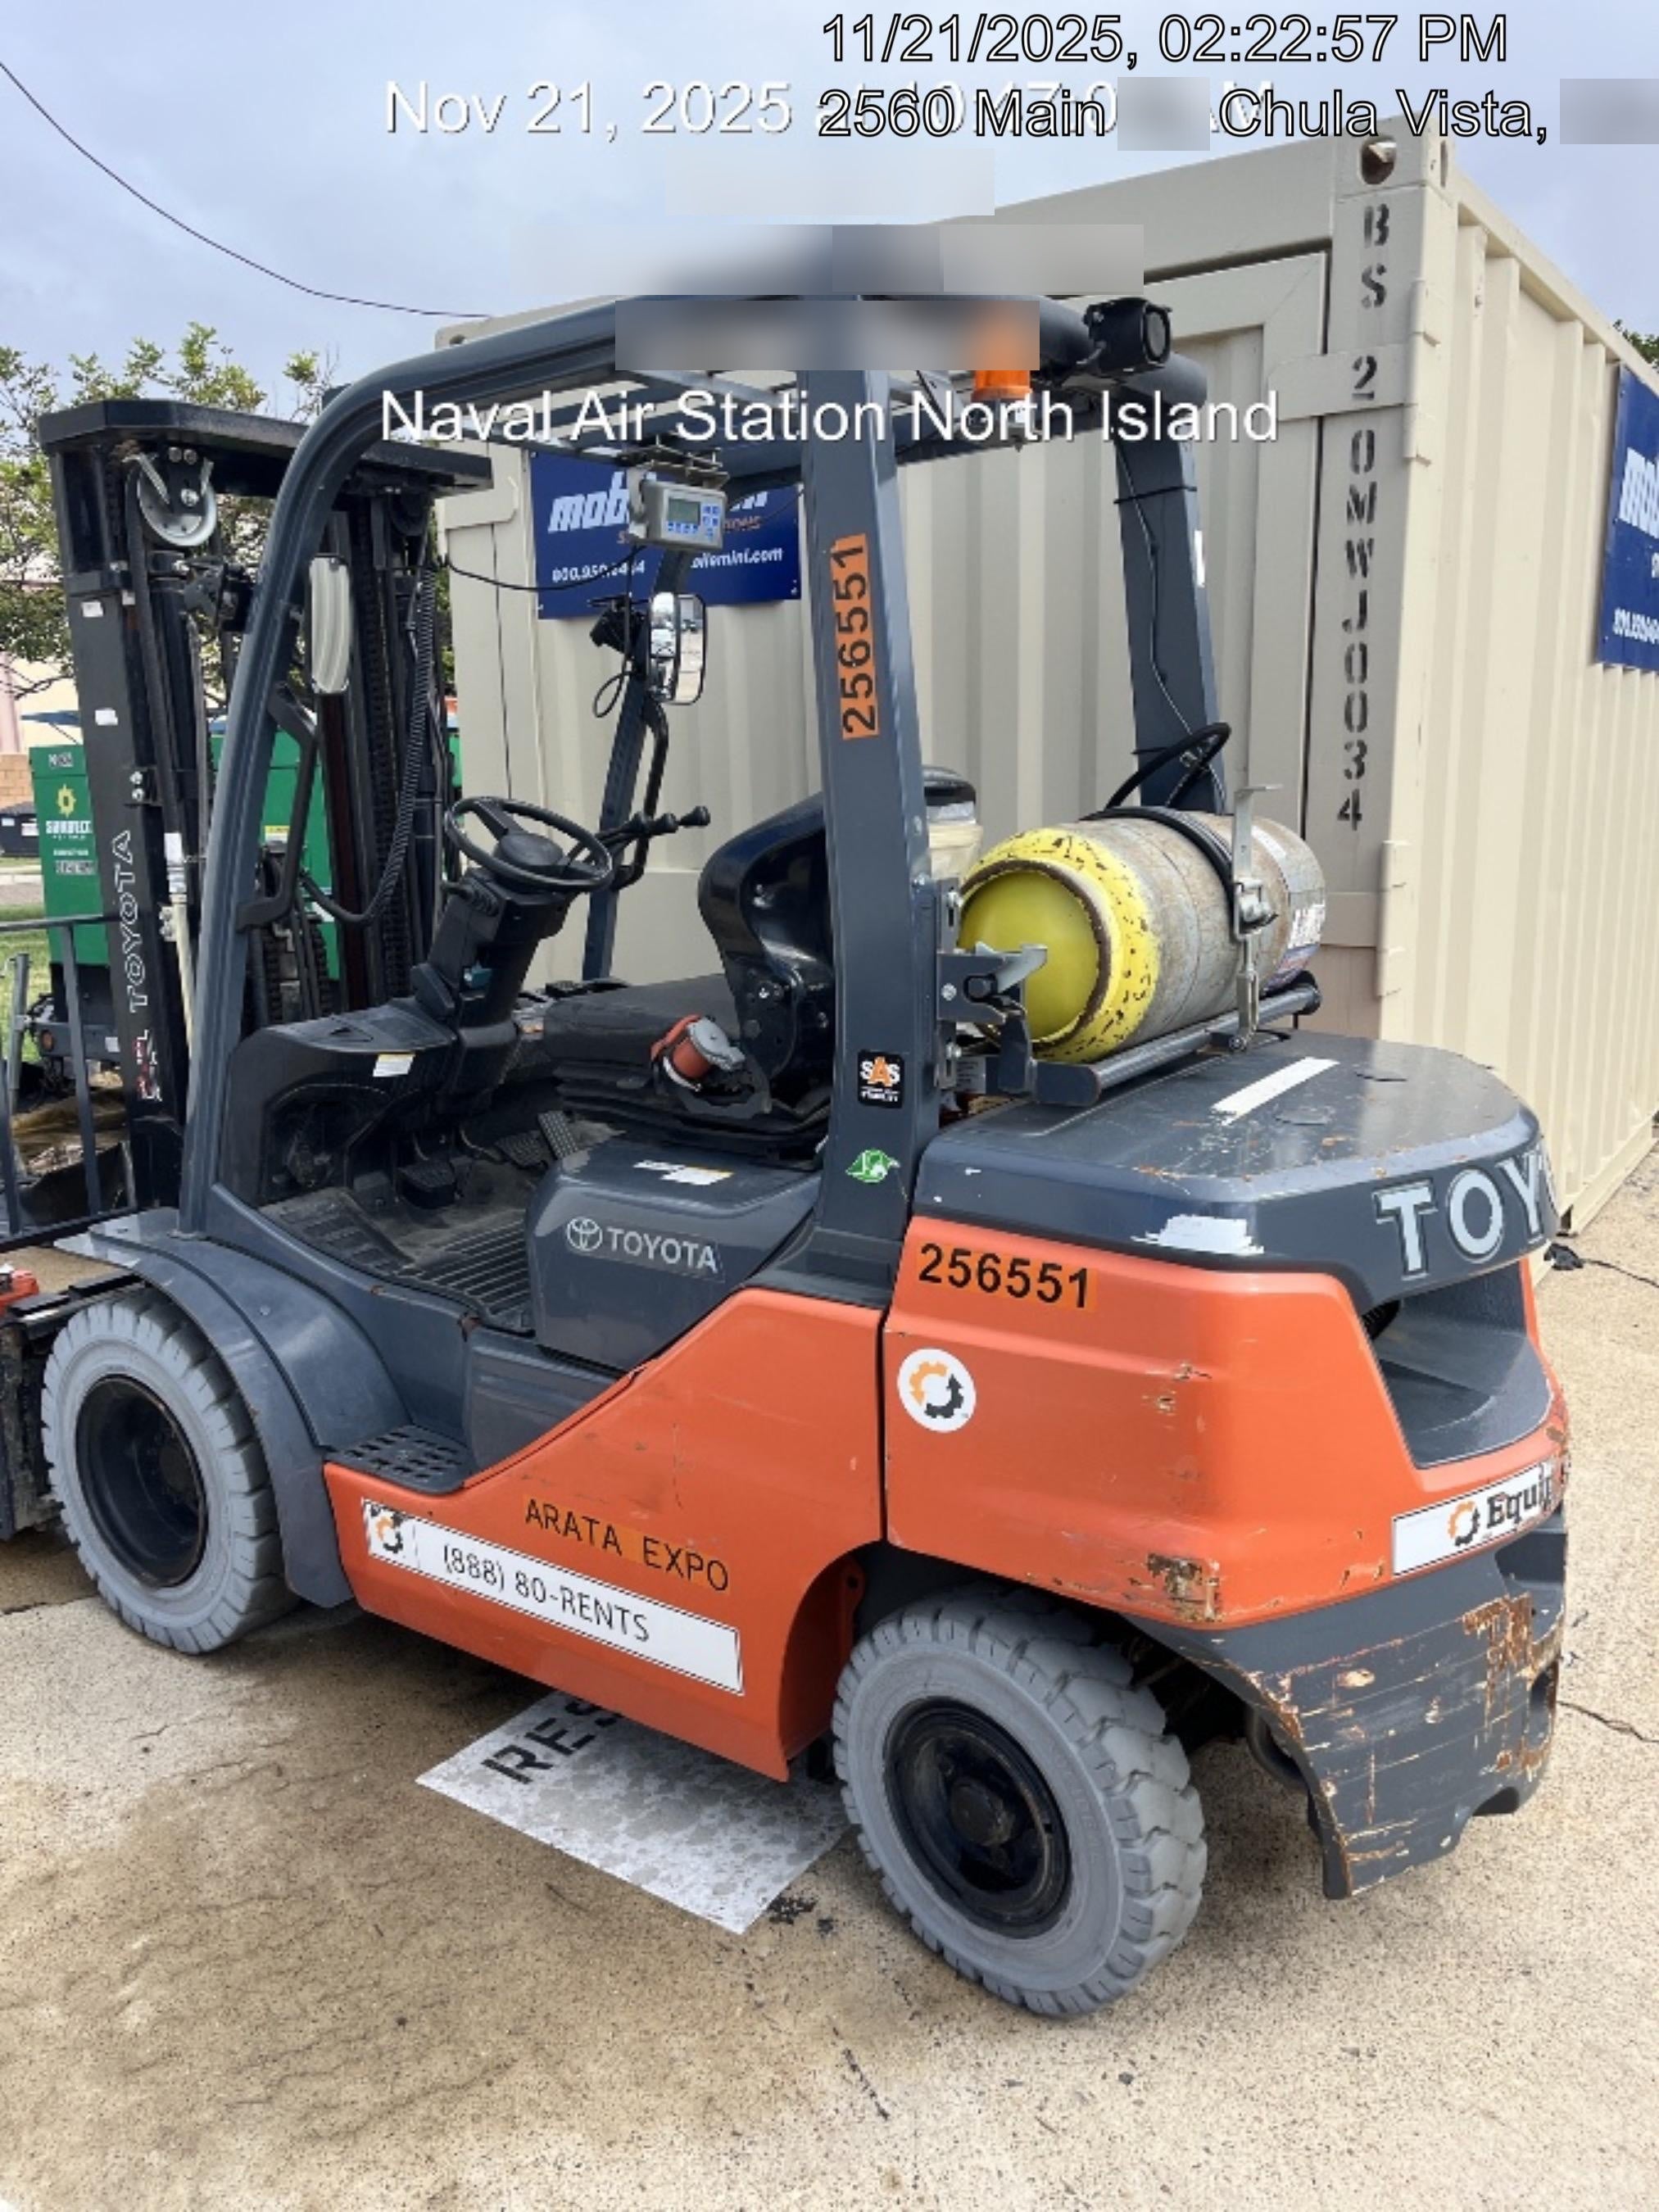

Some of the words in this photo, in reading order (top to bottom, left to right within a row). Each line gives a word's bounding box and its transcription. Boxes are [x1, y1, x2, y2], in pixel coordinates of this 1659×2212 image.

[832, 546, 877, 734] 256551
[112, 829, 149, 1013] TOYOTA
[859, 1055, 900, 1088] SAS
[607, 1226, 718, 1274] TOYOTA
[1371, 1145, 1547, 1281] TOY
[918, 1243, 1088, 1308] 256551
[443, 1543, 505, 1593] (888)
[514, 1571, 650, 1643] 80-RENTS
[525, 1498, 623, 1557] ARATA
[642, 1534, 729, 1592] EXPO
